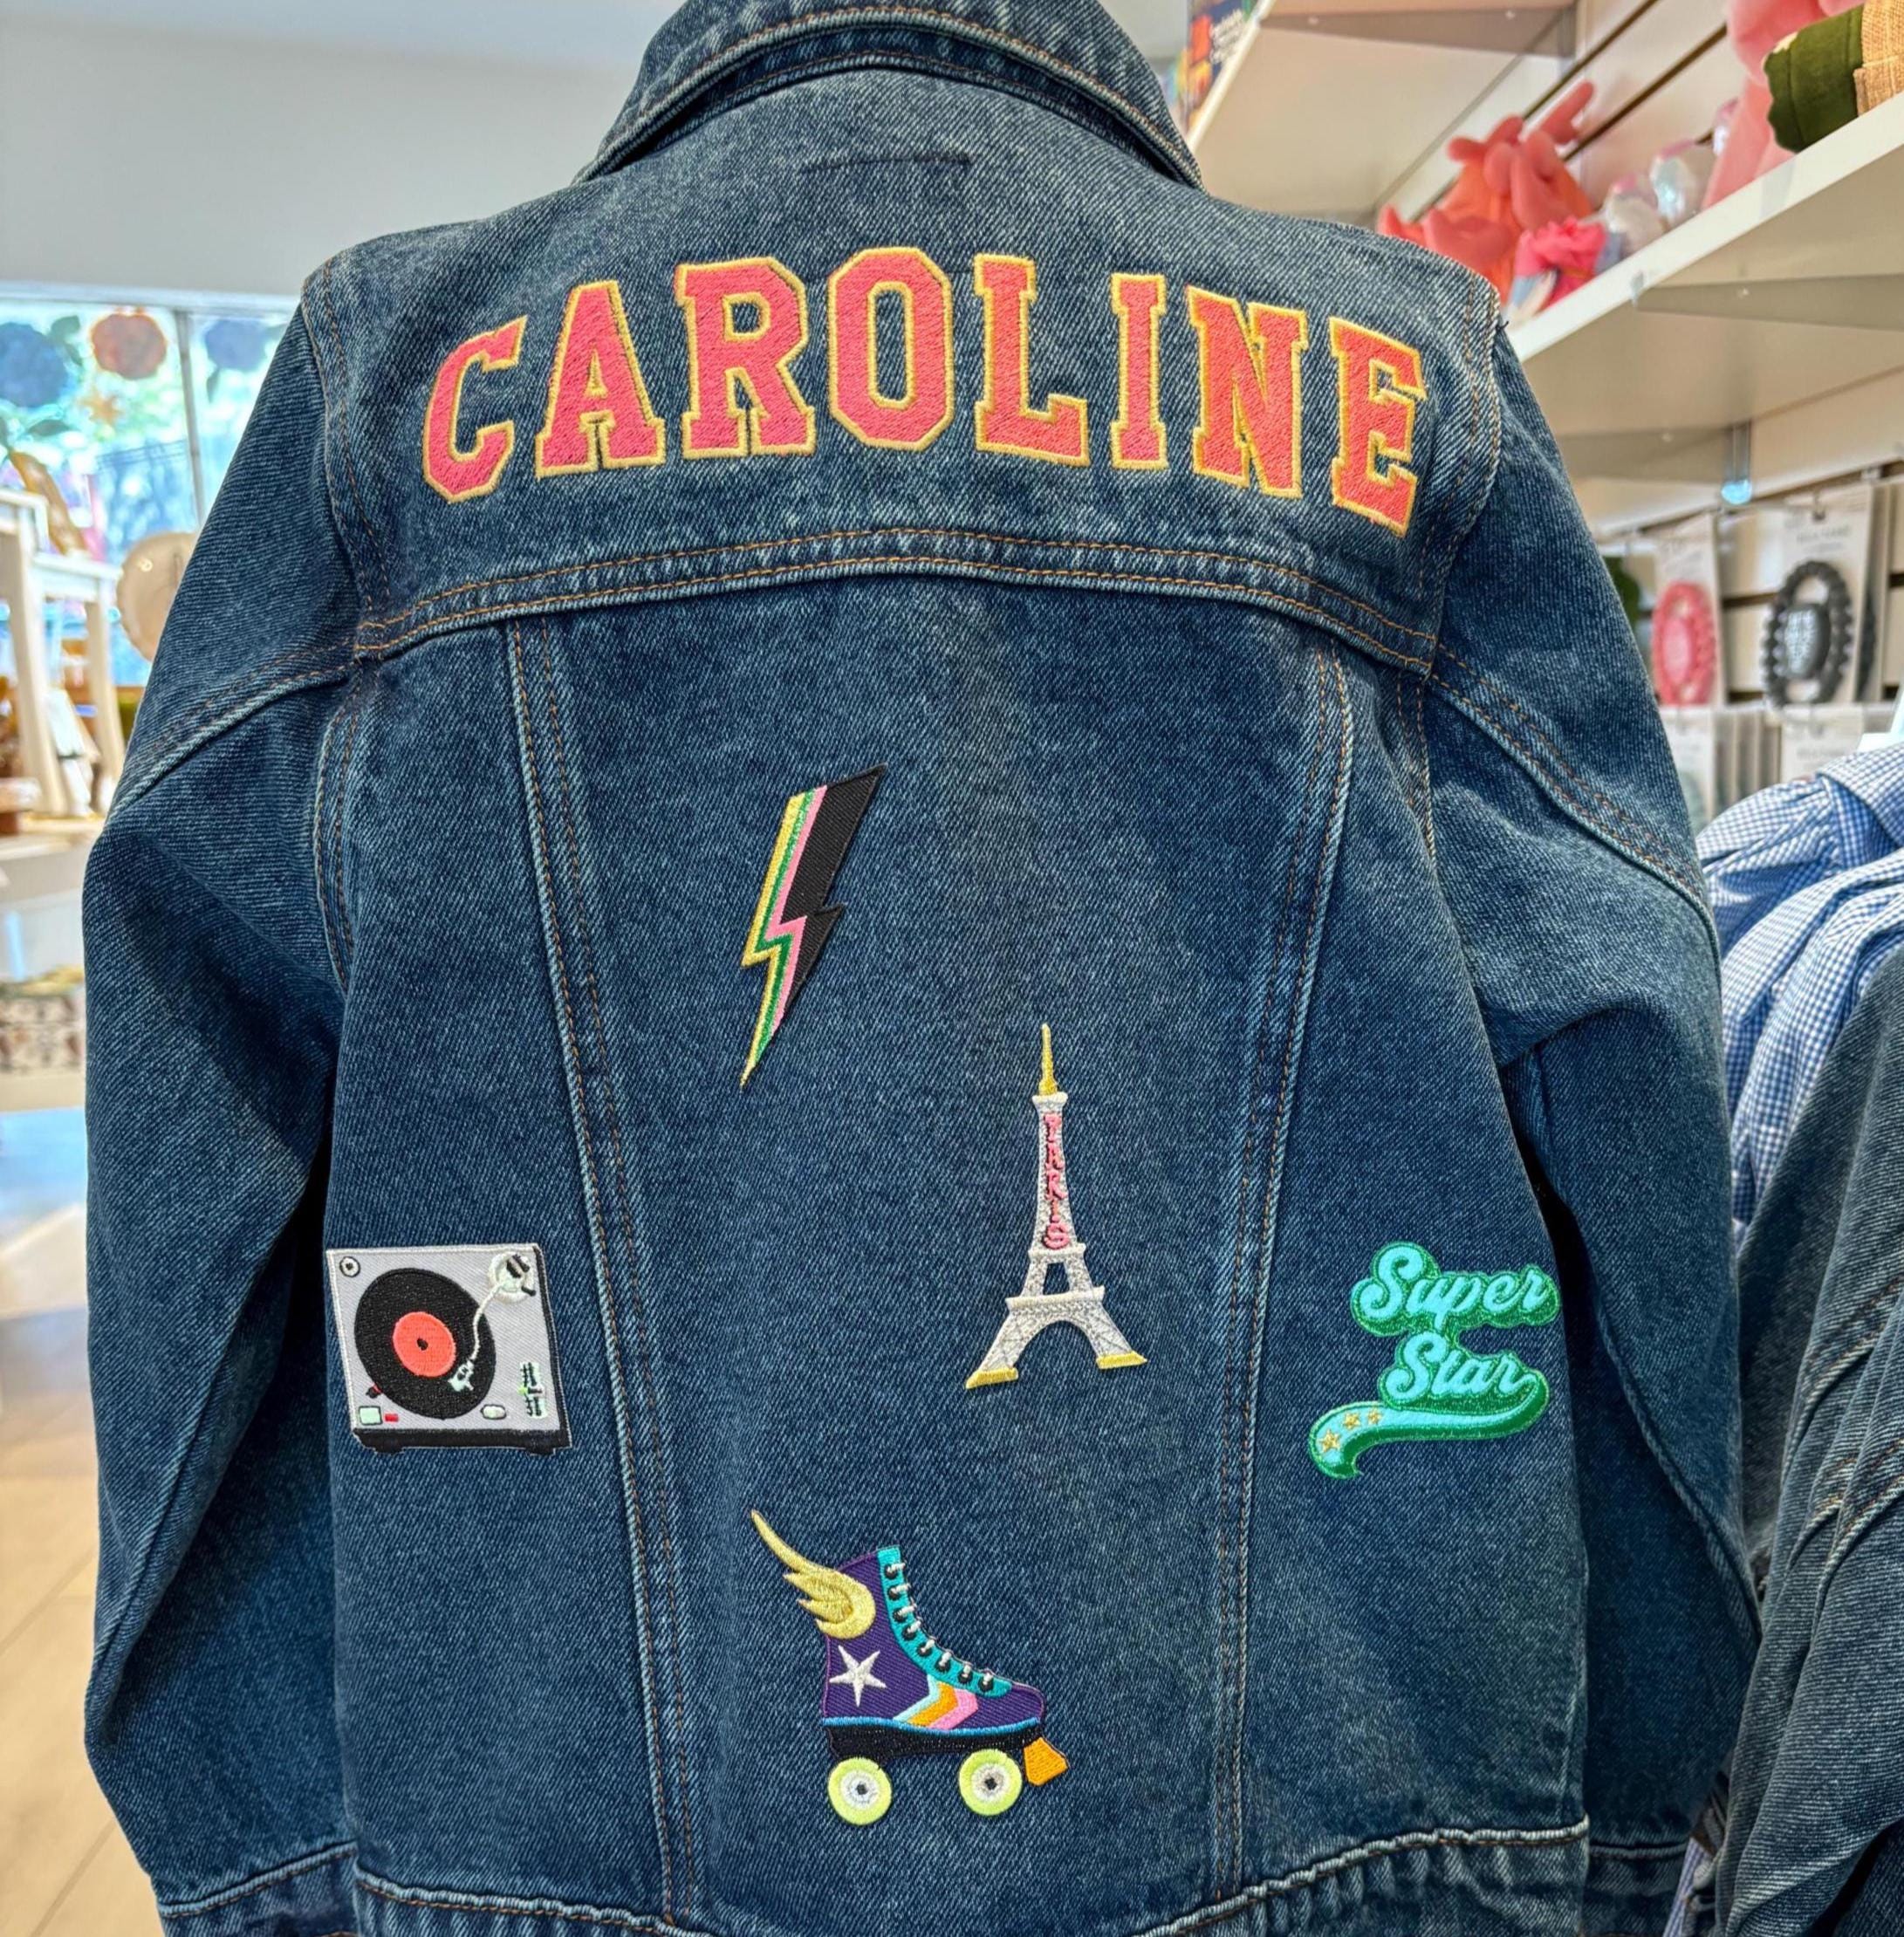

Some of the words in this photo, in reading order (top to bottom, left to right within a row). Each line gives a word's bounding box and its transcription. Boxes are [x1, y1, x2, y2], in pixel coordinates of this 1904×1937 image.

[421, 247, 1428, 535] CAROLINE
[1043, 1112, 1071, 1250] PARIS
[1357, 1242, 1553, 1332] Super
[1383, 1330, 1541, 1404] Star
